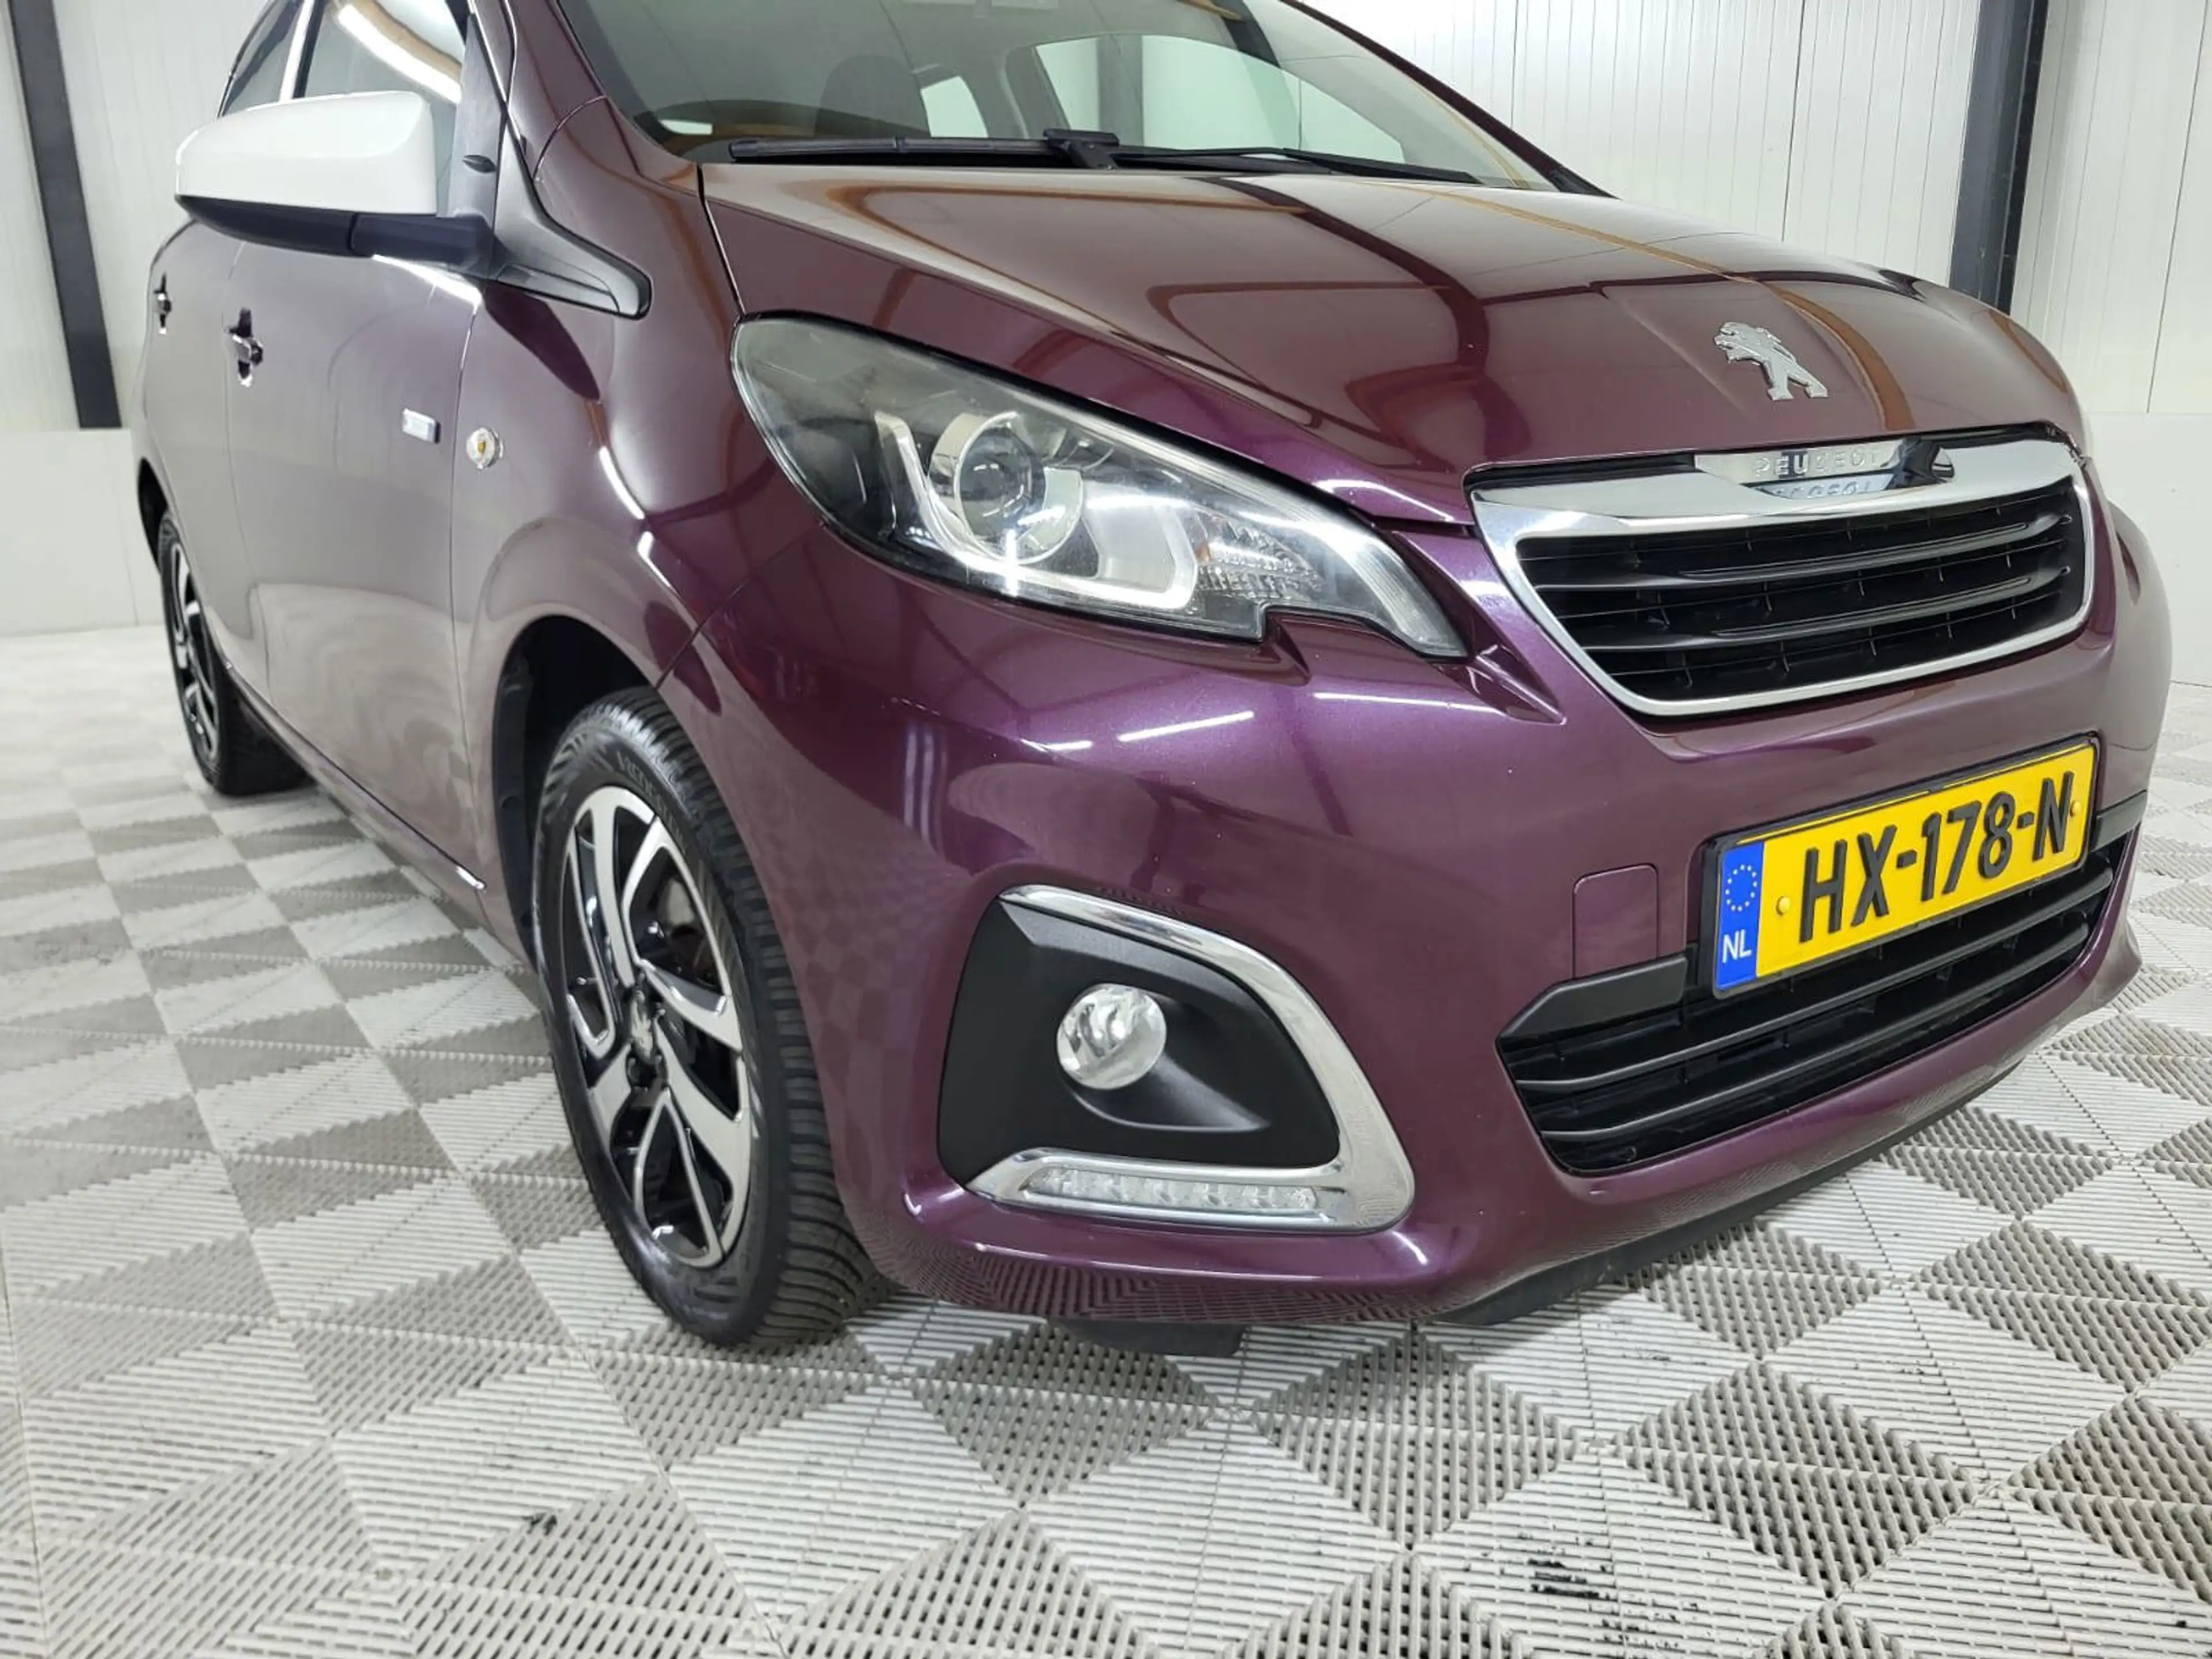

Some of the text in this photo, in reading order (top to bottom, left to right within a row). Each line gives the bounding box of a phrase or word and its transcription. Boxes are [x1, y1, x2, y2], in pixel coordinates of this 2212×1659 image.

[1756, 449, 1881, 477] PEUGEOT
[1799, 771, 2074, 944] HX-178-N
[1722, 929, 1752, 963] NL
